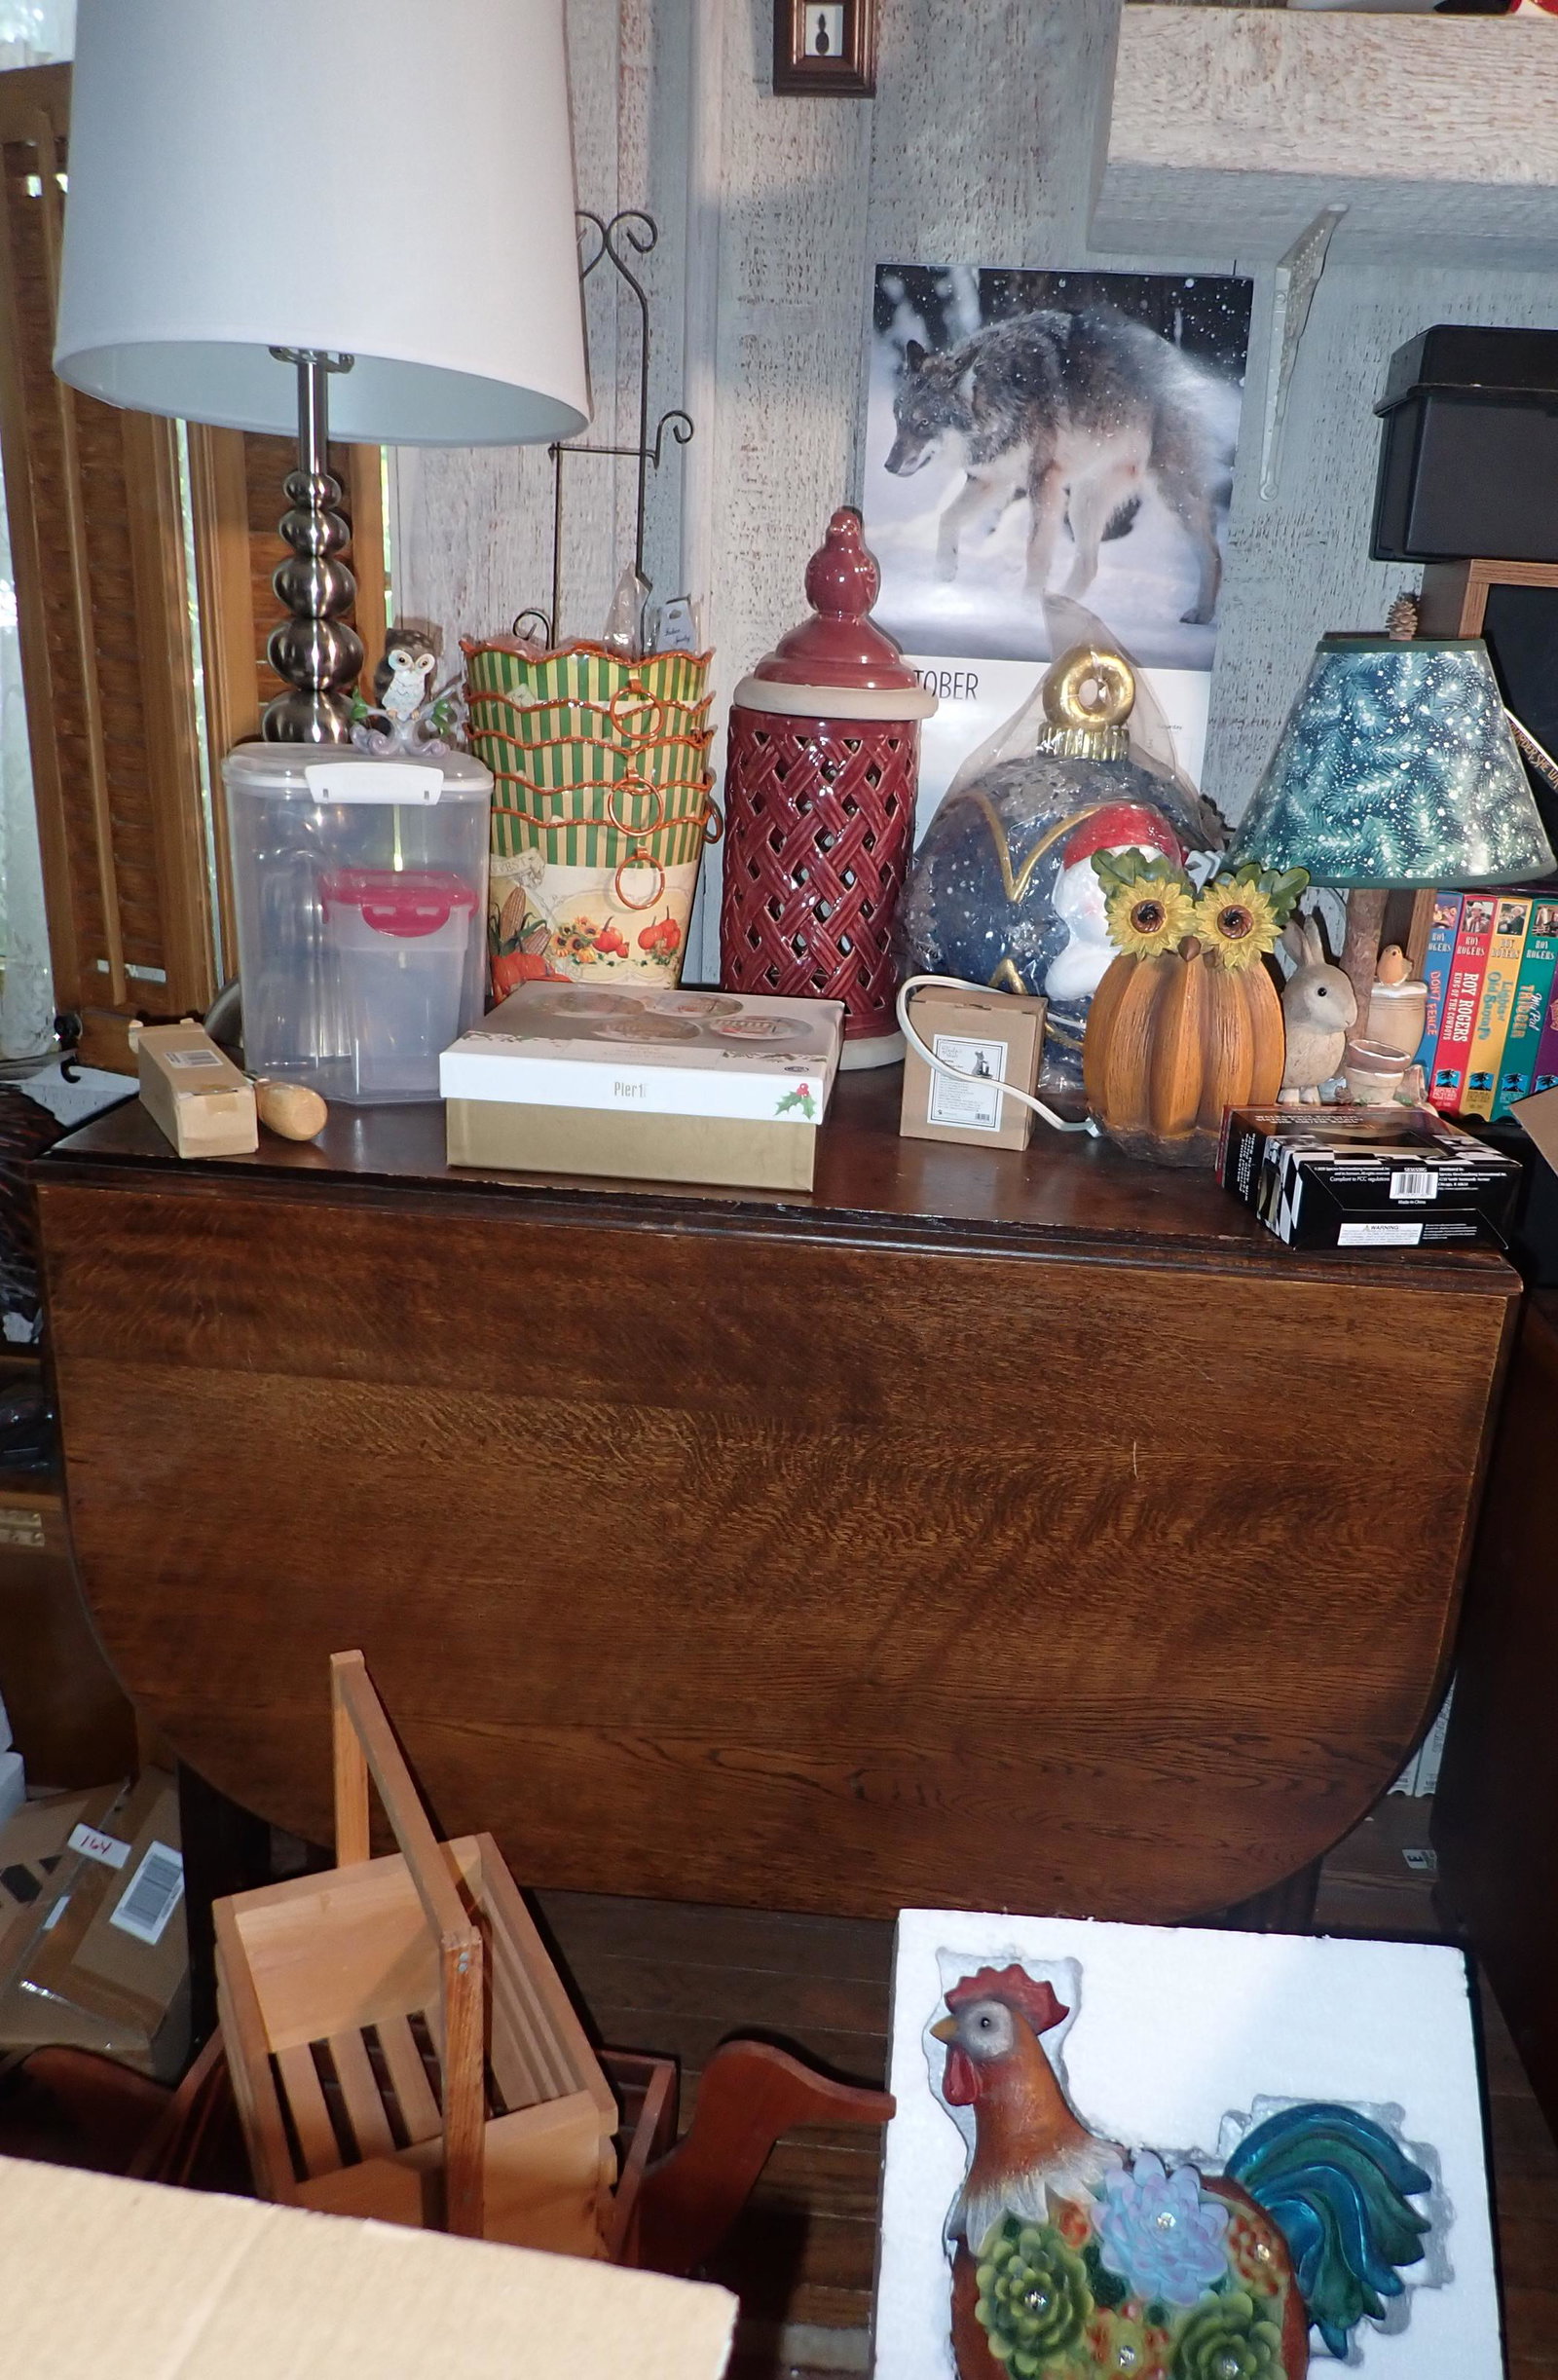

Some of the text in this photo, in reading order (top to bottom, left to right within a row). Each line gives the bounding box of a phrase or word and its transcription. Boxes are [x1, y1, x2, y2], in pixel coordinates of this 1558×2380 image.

[913, 670, 979, 700] TOBER
[1428, 943, 1451, 952] OGERS
[1465, 936, 1479, 946] ROY
[1535, 941, 1549, 949] ROY
[1457, 946, 1485, 956] ROGERS
[1526, 949, 1555, 960] ROGERS
[1453, 972, 1462, 988] KING
[1487, 971, 1502, 992] Old
[1448, 999, 1458, 1012] THE
[1453, 973, 1479, 1042] ROY ROGERS
[1427, 1003, 1437, 1036] FENCE
[1442, 1012, 1455, 1040] COWBOYS
[1529, 1010, 1541, 1031] Pal
